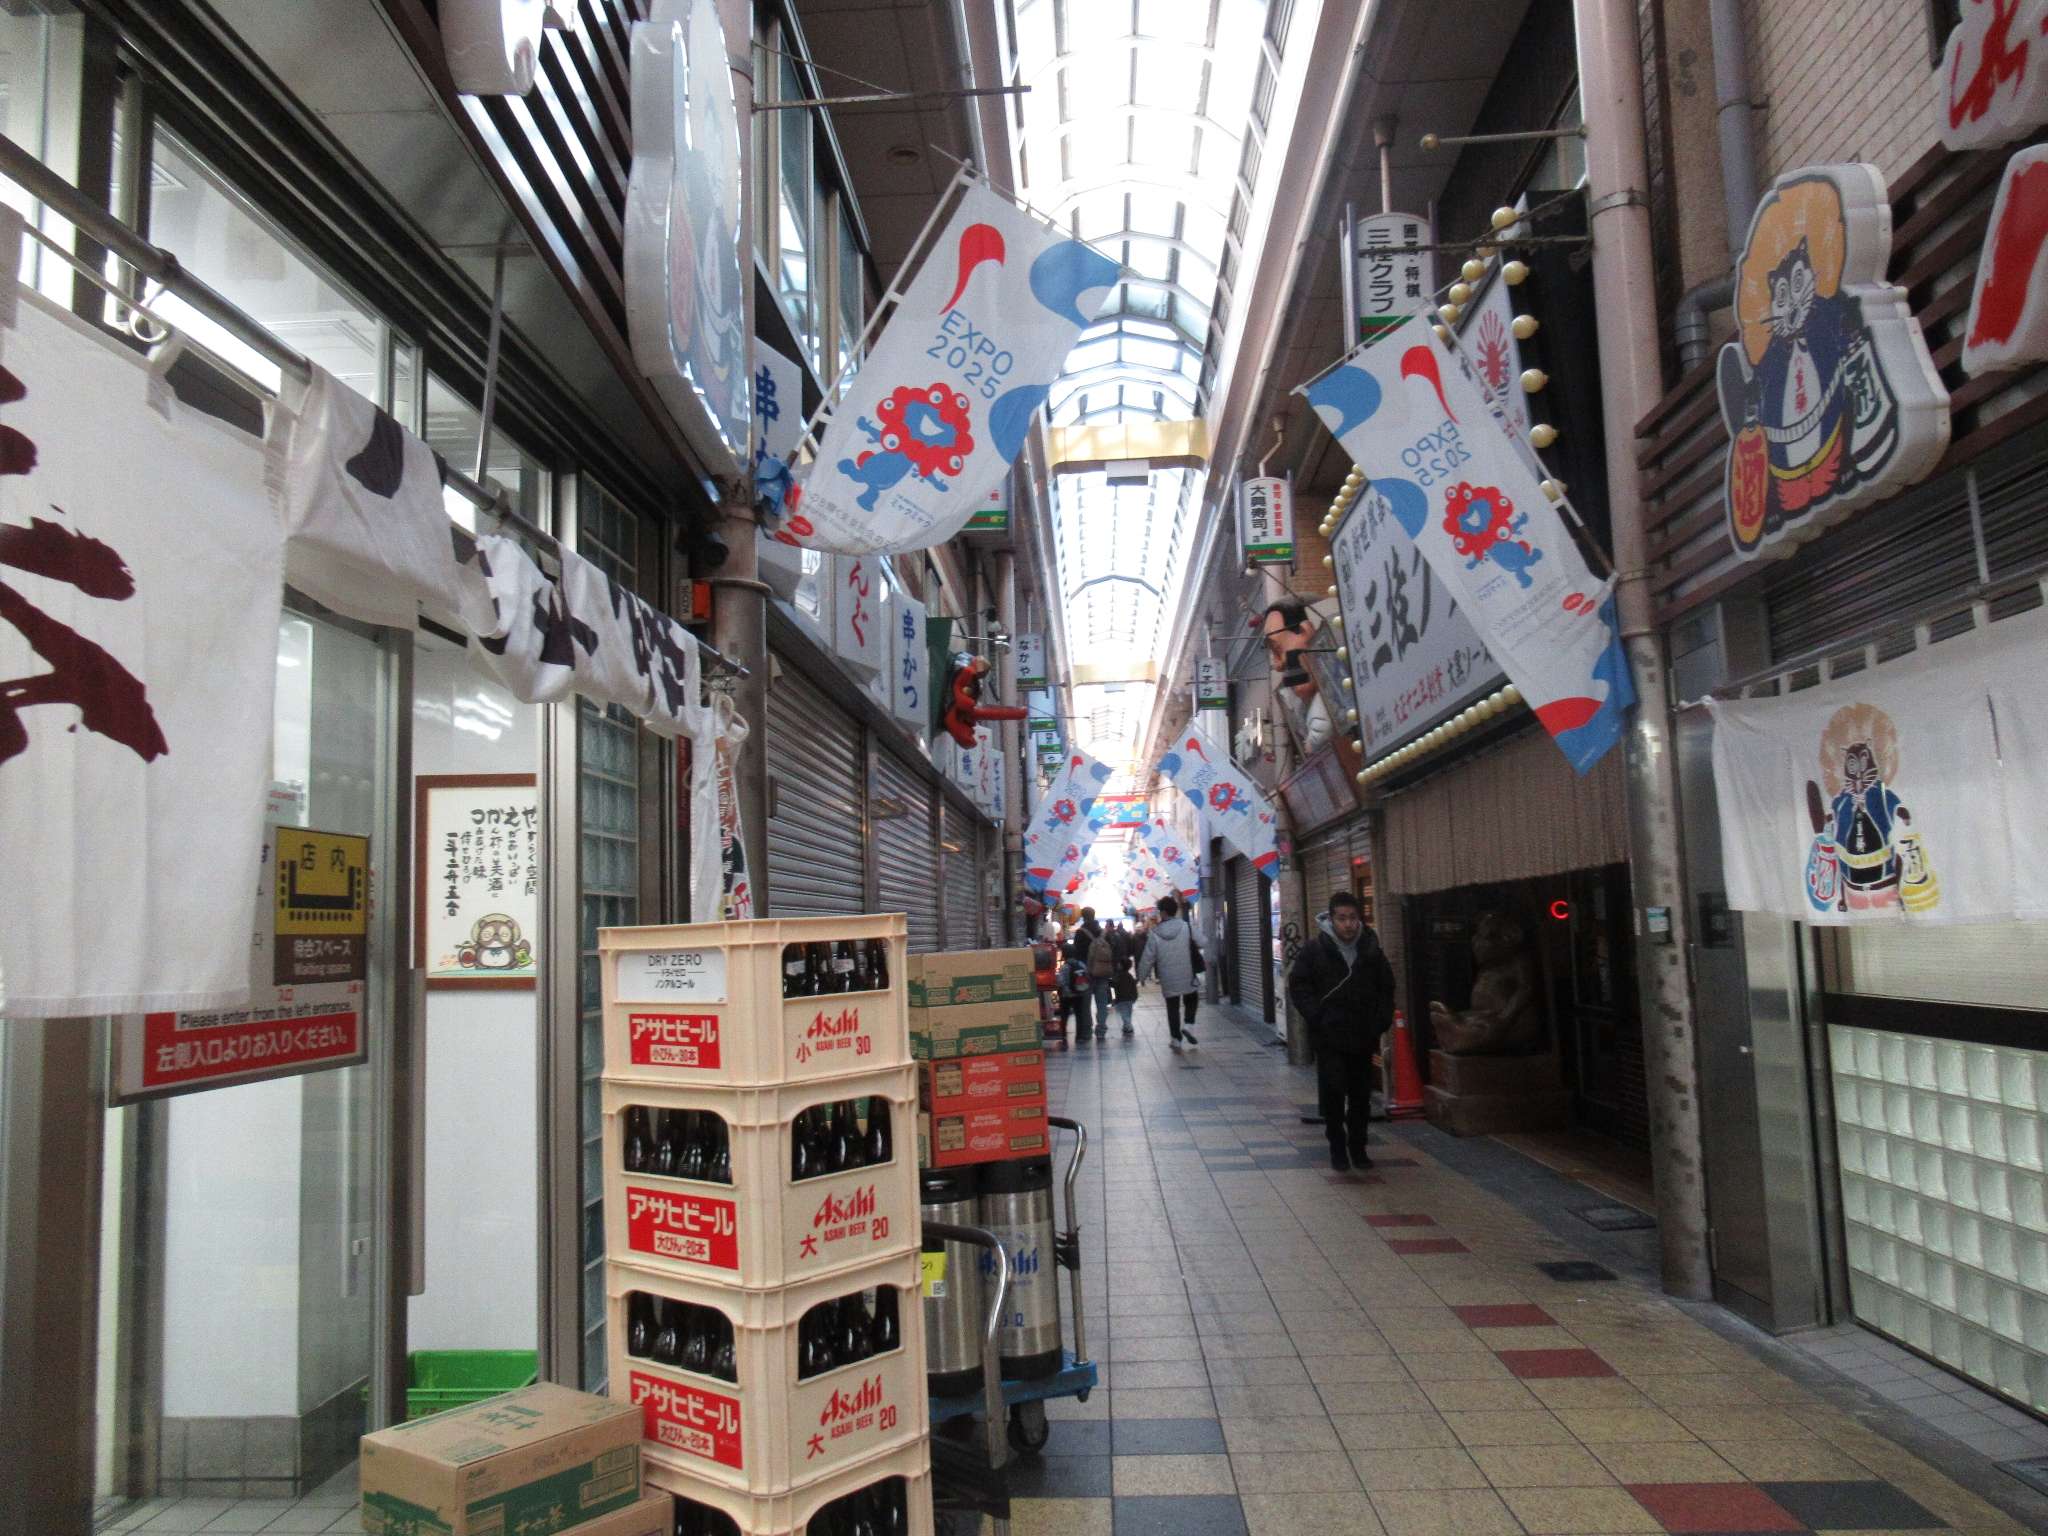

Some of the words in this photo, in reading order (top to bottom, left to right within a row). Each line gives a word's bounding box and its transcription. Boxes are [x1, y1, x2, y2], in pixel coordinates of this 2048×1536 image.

[941, 309, 1013, 375] EXPO
[926, 334, 1001, 399] 2025
[903, 608, 918, 709] 串かつ
[647, 954, 669, 967] DRY
[671, 952, 703, 967] ZERO
[180, 1012, 218, 1029] Please
[222, 1011, 249, 1024] enter
[252, 1007, 276, 1022] from
[631, 1018, 717, 1044] アサヒビール
[806, 1007, 860, 1039] Asahi
[156, 1024, 348, 1073] 左側入口よりお入りください。
[796, 1042, 812, 1064] 小
[855, 1034, 872, 1056] 30
[628, 1193, 735, 1237] アサヒビール
[813, 1183, 876, 1229] Asahi
[800, 1233, 818, 1260] 大
[871, 1215, 889, 1241] 20
[632, 1377, 739, 1435] アサヒビール
[820, 1373, 883, 1427] Asahi
[806, 1432, 825, 1461] 大
[879, 1403, 897, 1432] 20
